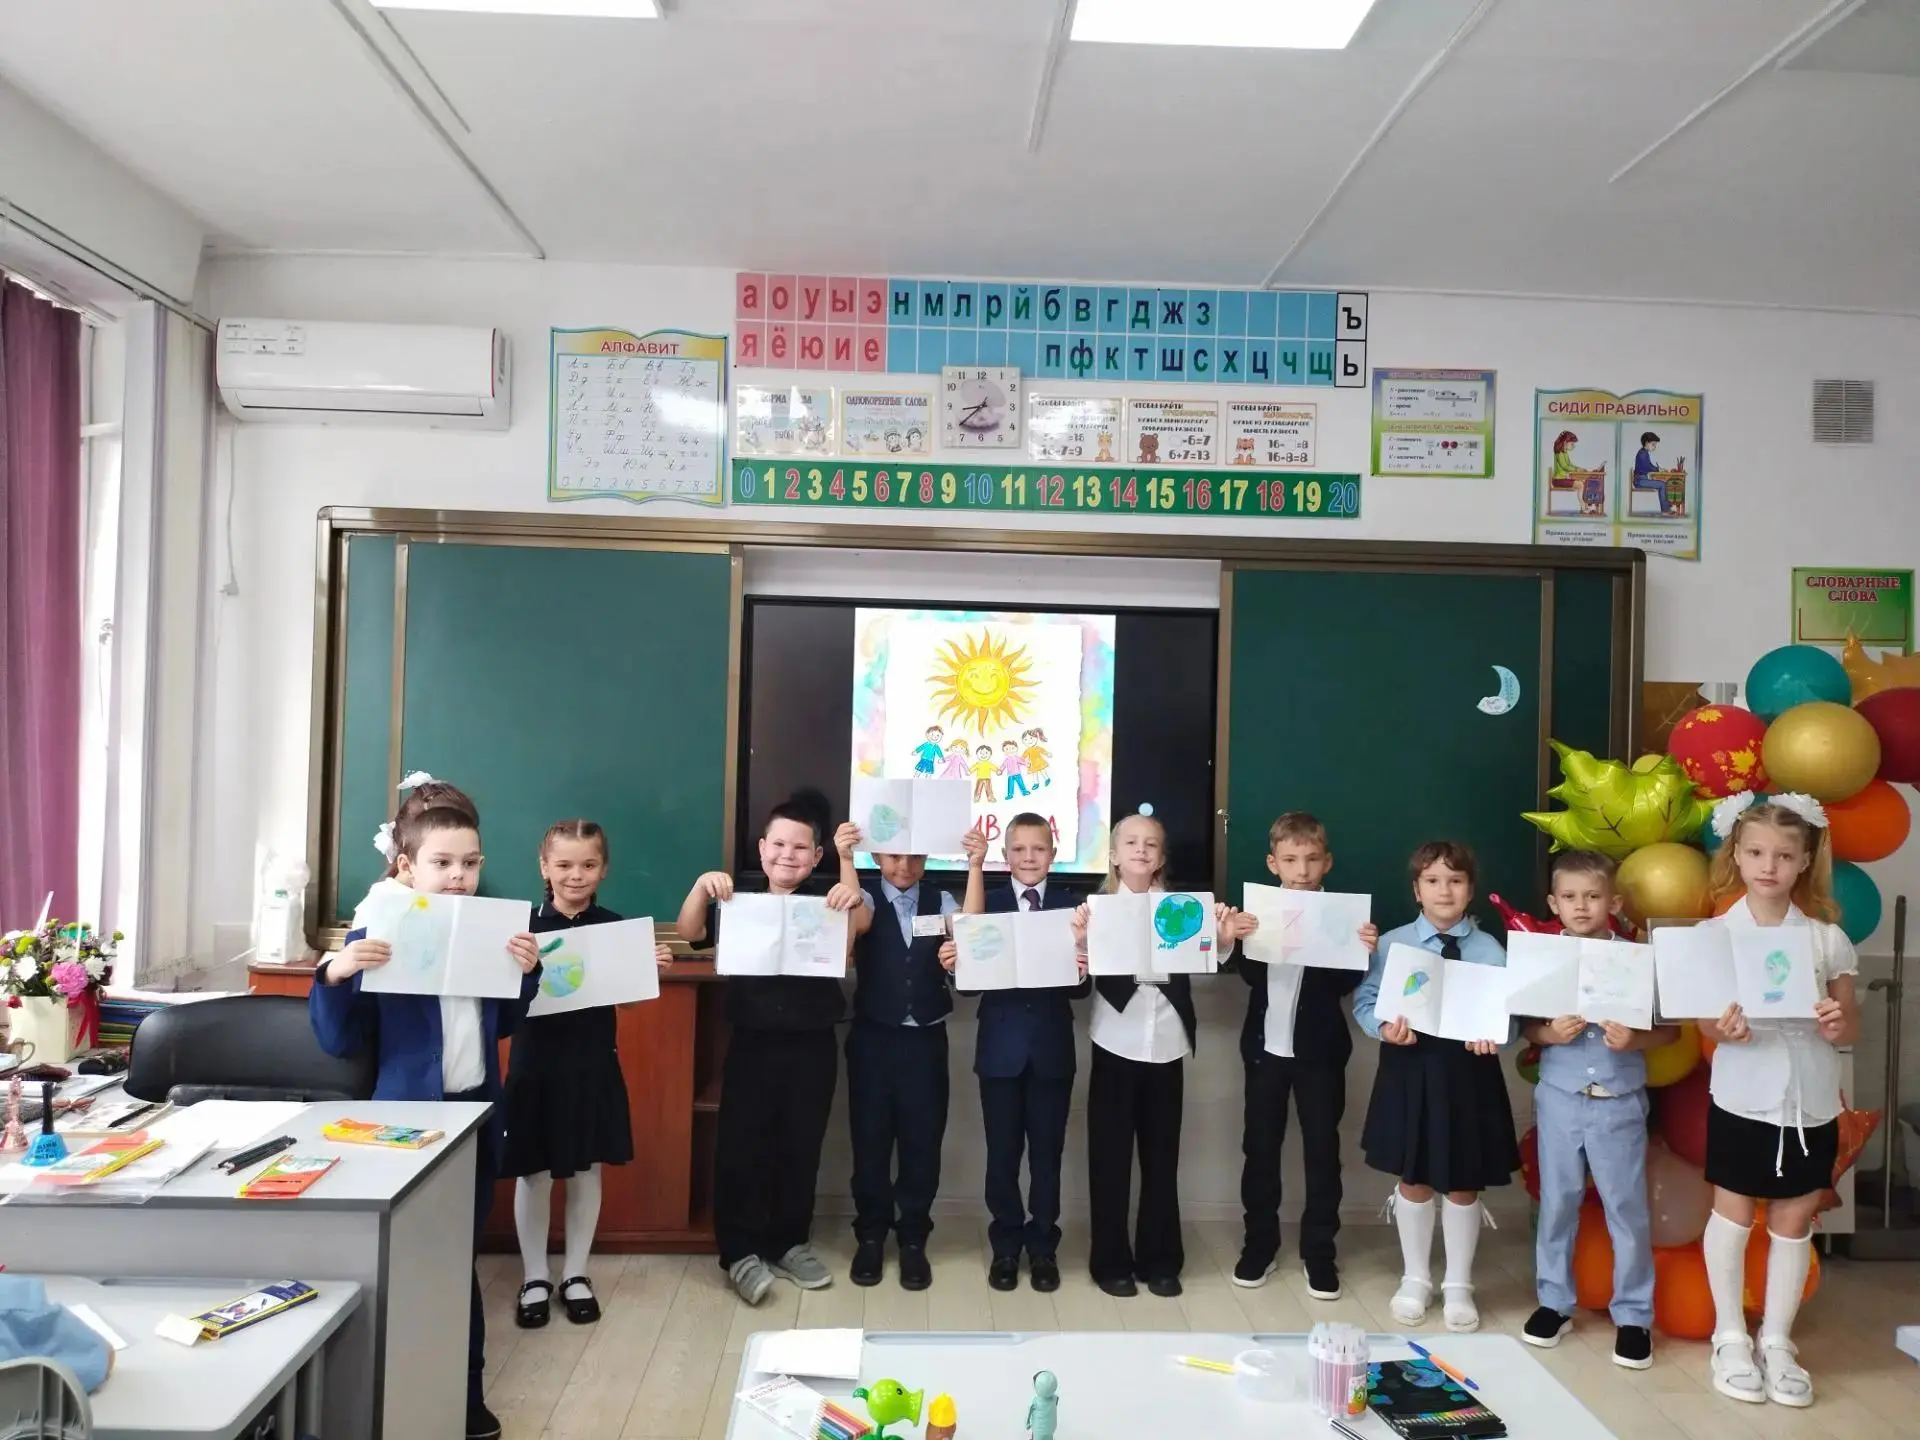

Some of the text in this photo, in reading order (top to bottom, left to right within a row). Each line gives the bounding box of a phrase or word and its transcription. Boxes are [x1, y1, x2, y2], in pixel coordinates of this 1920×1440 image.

[742, 284, 758, 309] а
[772, 286, 789, 310] о
[804, 288, 821, 319] у
[832, 288, 854, 312] ы
[866, 290, 882, 314] э
[894, 291, 909, 315] н
[924, 292, 943, 316] м
[953, 293, 971, 317] л
[986, 294, 1001, 325] р
[1015, 287, 1030, 319] й
[1044, 289, 1060, 321] б
[1075, 299, 1090, 322] в
[1106, 299, 1119, 322] г
[1131, 300, 1150, 329] д
[1162, 301, 1184, 324] ж
[1196, 302, 1210, 325] з
[601, 341, 679, 355] АЛФАВИТ
[742, 333, 757, 357] я
[771, 327, 786, 359] ё
[801, 336, 823, 360] ю
[835, 337, 850, 361] и
[864, 338, 880, 362] е
[1046, 345, 1060, 367] п
[1070, 338, 1093, 377] ф
[1106, 347, 1119, 370] к
[1134, 348, 1149, 371] т
[1162, 349, 1183, 371] ш
[1193, 349, 1209, 372] с
[1223, 350, 1238, 373] х
[1253, 351, 1268, 379] ц
[1283, 352, 1297, 374] ч
[1310, 352, 1332, 380] щ
[958, 371, 966, 379] 11
[977, 371, 987, 379] 12
[999, 371, 1004, 379] 1
[947, 383, 956, 391] 10
[1009, 384, 1016, 392] 2
[946, 402, 953, 410] 9
[1009, 403, 1016, 411] 3
[1548, 401, 1690, 417] СИДИ ПРАВИЛЬНО
[946, 422, 953, 430] 8
[1009, 423, 1016, 431] 4
[960, 433, 965, 442] 7
[978, 433, 984, 441] 6
[997, 434, 1003, 442] 5
[1169, 449, 1210, 461] 6+7=13
[1267, 452, 1308, 463] 16-8=8
[739, 467, 1358, 514] 0 1 2 3 4 5 6 7 8 9 10 11 12 13 14 15 16 17 18 19 20
[1806, 576, 1900, 589] СЛОВАРНЫЕ
[1828, 590, 1878, 602] СЛОВА
